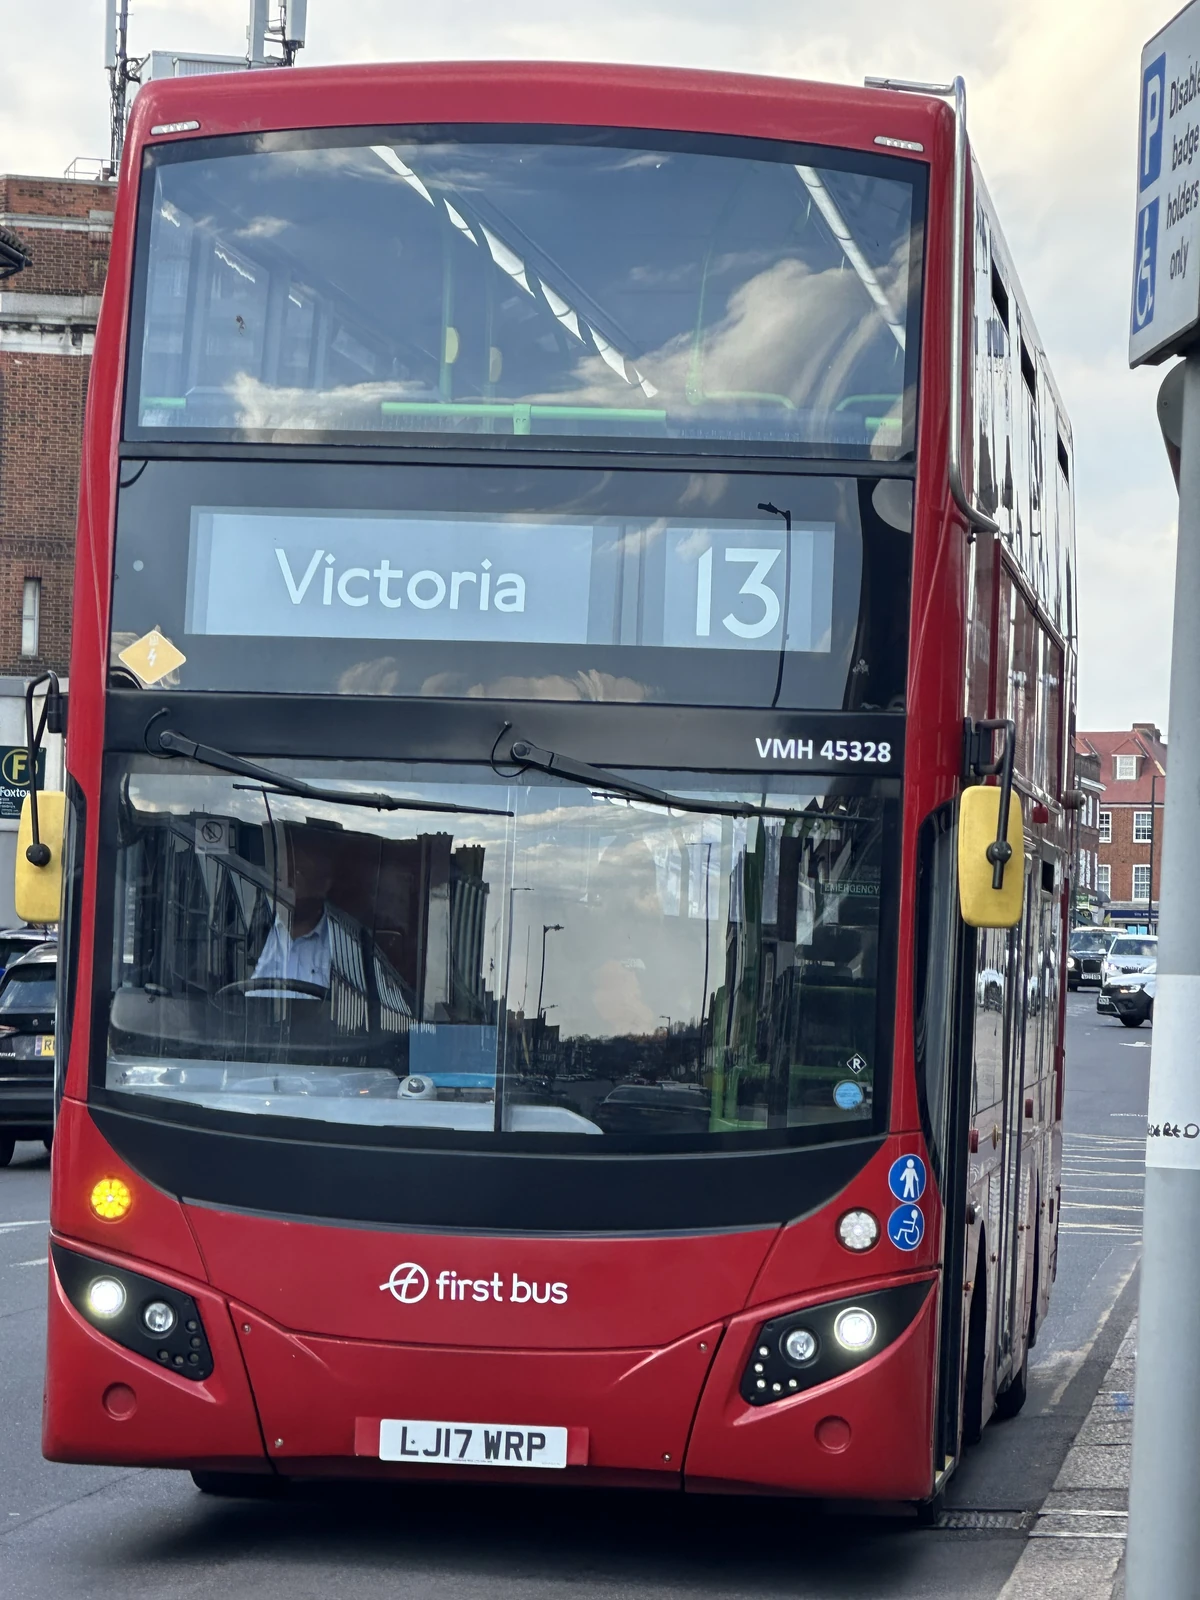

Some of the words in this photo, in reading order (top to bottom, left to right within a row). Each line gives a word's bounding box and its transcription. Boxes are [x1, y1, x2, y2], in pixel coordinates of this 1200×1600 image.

[1172, 122, 1199, 171] badge
[1166, 180, 1199, 230] holders
[1170, 236, 1189, 280] only
[275, 547, 526, 613] Victoria
[696, 546, 783, 640] 13
[755, 737, 814, 760] VMH
[820, 740, 891, 763] 45328
[824, 883, 880, 895] EMERGENCY
[852, 1058, 862, 1070] R
[435, 1270, 503, 1302] first
[509, 1272, 569, 1305] bus
[400, 1426, 473, 1458] LJ17
[483, 1430, 546, 1462] WRP
